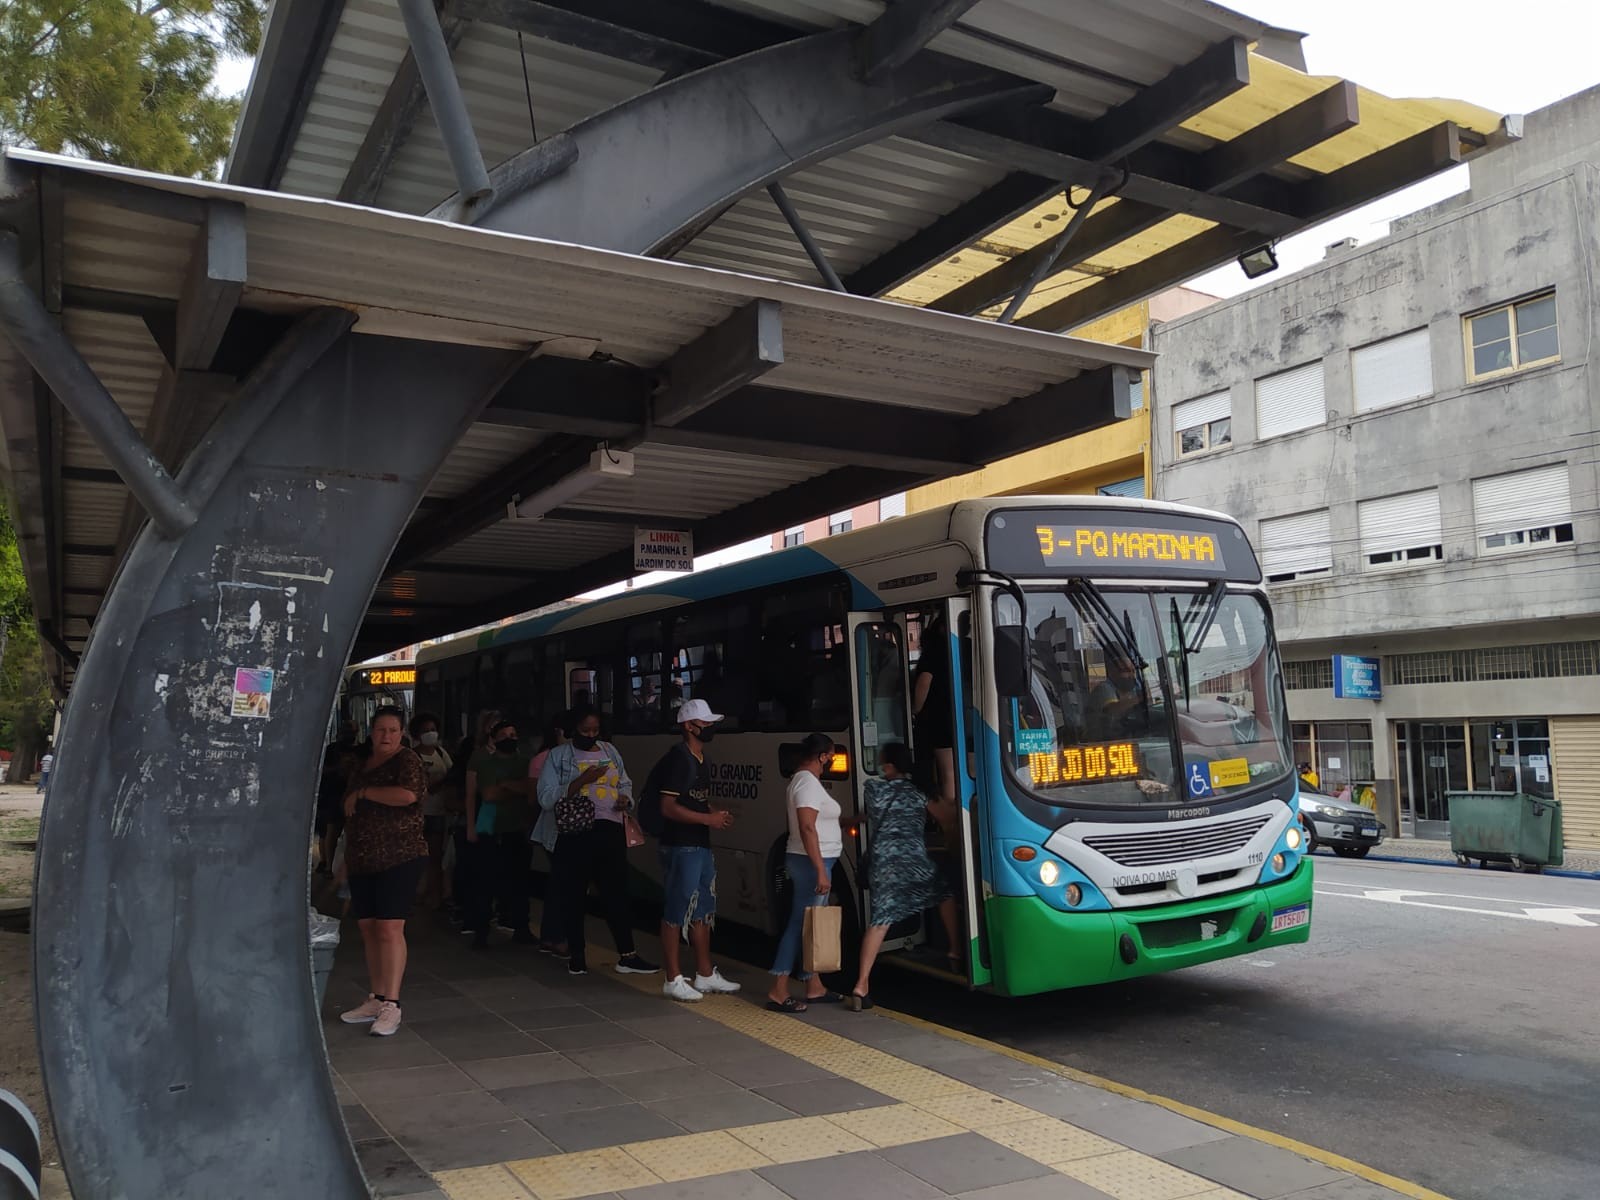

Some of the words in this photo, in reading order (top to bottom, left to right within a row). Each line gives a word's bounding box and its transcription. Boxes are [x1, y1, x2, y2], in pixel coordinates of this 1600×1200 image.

[649, 531, 681, 543] LINHA
[682, 545, 687, 556] E
[1036, 528, 1054, 555] 3
[1076, 529, 1108, 557] PQ
[1112, 531, 1214, 561] MARINHA
[635, 558, 663, 569] JARDIM
[665, 559, 676, 569] DO
[678, 560, 693, 570] SOL
[370, 671, 383, 685] 22
[1021, 732, 1048, 741] TARIFA
[1029, 751, 1059, 783] VIA
[1062, 748, 1083, 780] JD
[1085, 746, 1107, 778] DO
[1108, 743, 1138, 776] SOL
[720, 763, 762, 782] GRANDE
[1168, 806, 1210, 819] Marcopolo
[1247, 851, 1263, 865] 1110
[1112, 874, 1140, 887] NOIVA
[1142, 871, 1156, 882] DO
[1158, 869, 1177, 882] MAR
